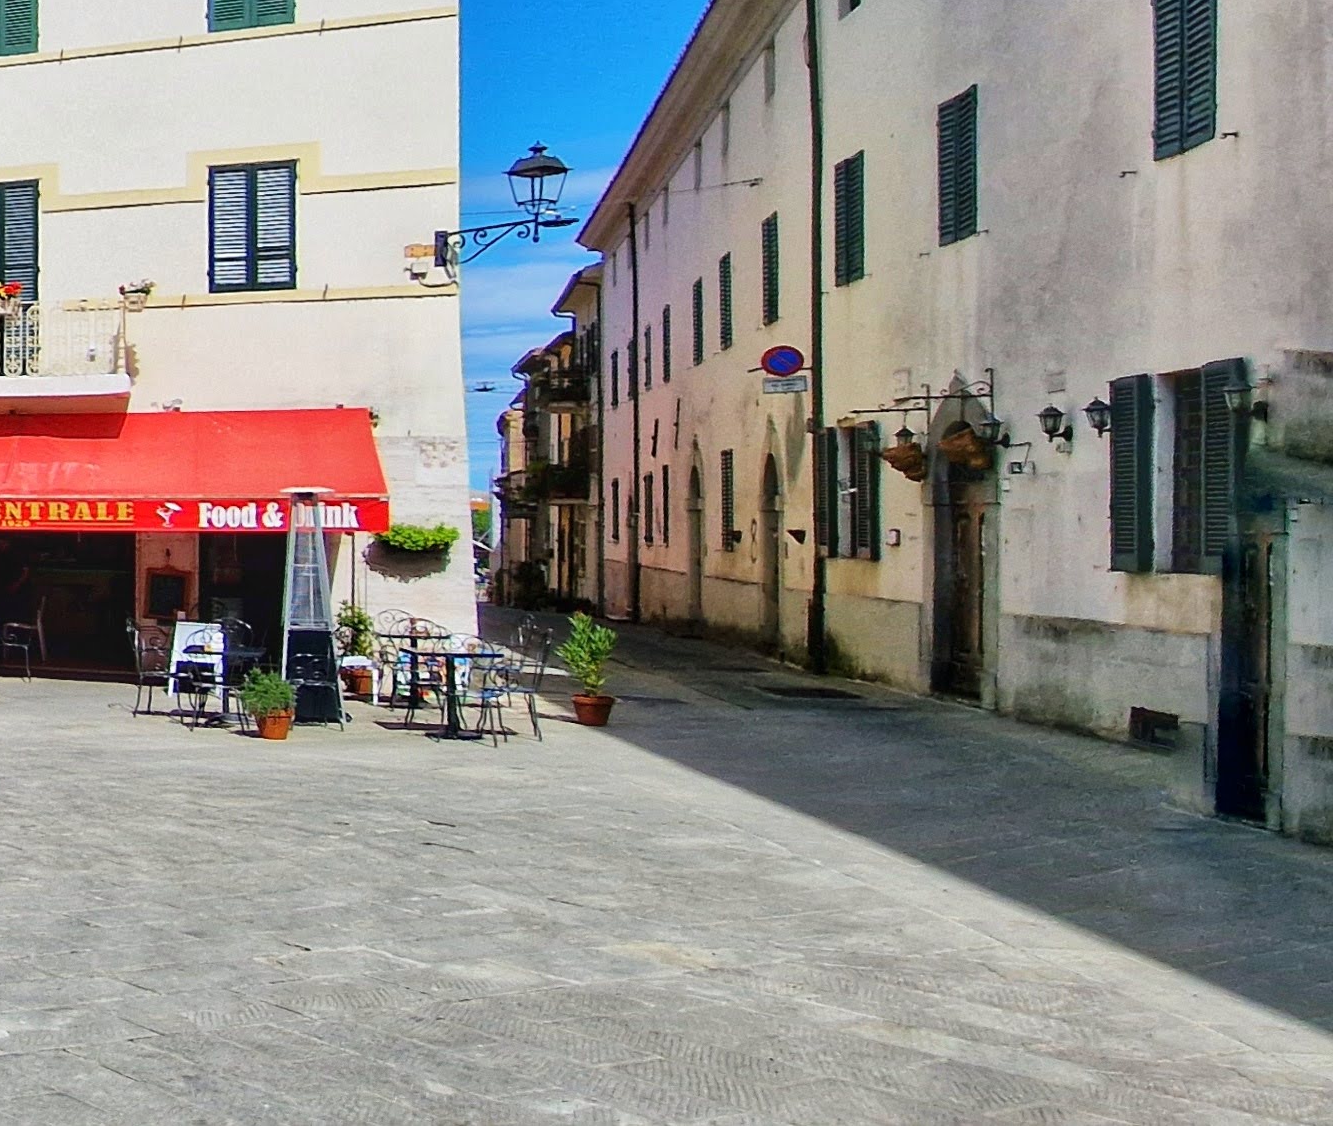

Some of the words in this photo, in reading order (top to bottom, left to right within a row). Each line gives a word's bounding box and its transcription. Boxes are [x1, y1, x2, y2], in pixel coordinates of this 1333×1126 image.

[2, 519, 31, 527] 1920
[198, 501, 258, 528] Food
[261, 501, 284, 528] &
